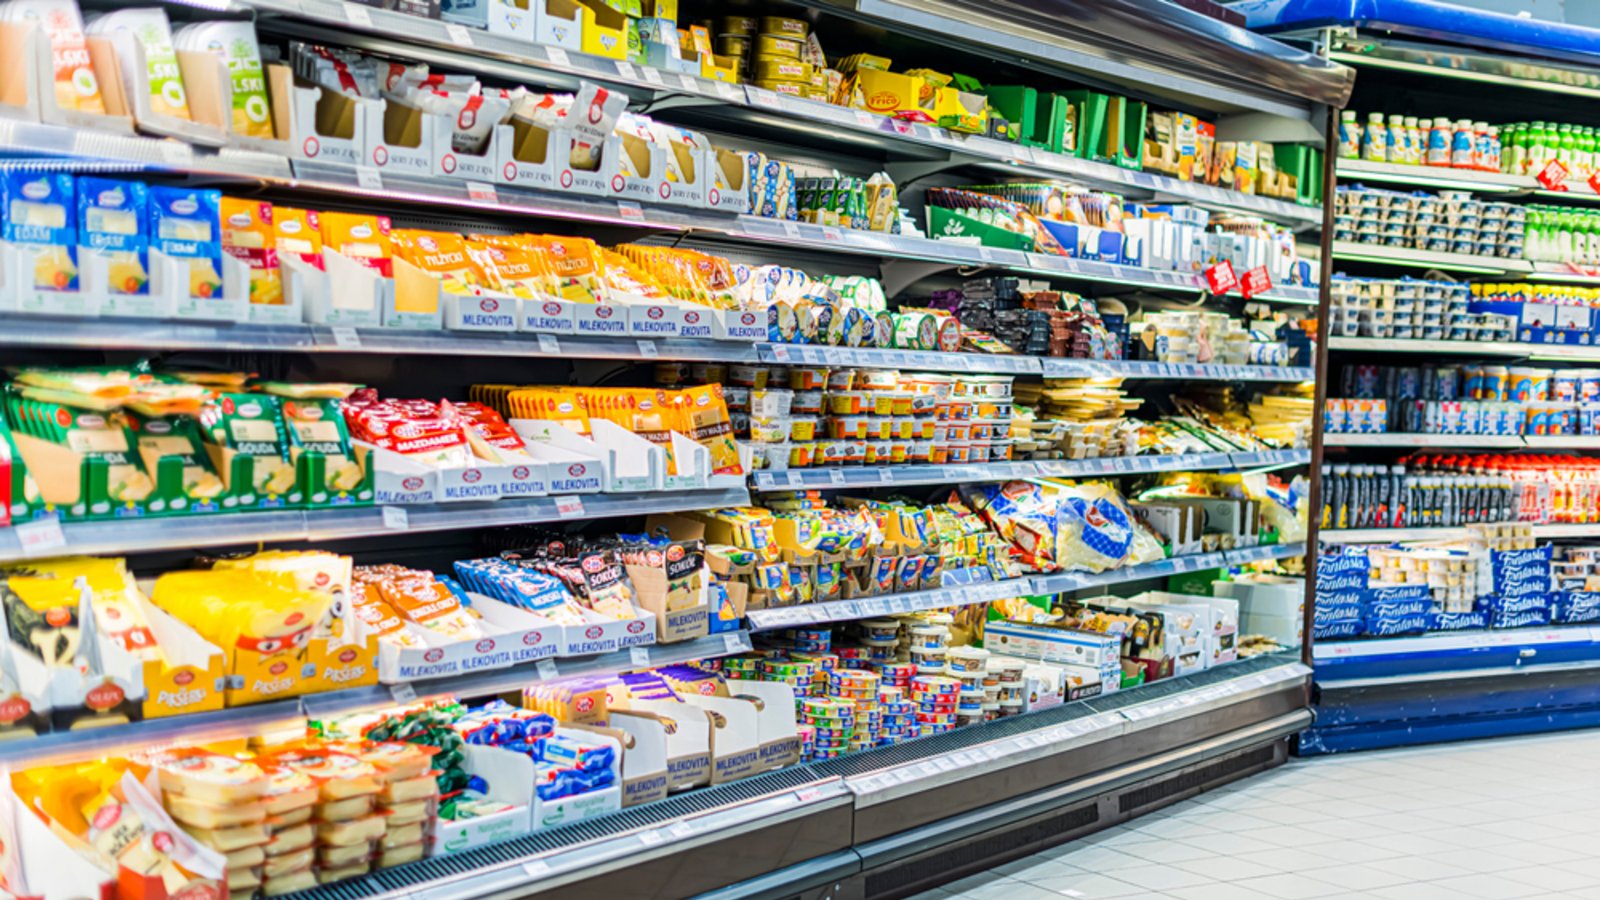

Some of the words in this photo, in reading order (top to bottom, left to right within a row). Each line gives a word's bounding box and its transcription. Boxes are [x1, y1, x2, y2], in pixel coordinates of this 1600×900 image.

[463, 314, 513, 326] MLEKOVITA
[526, 317, 572, 330] MLEKOVITA
[579, 320, 624, 331] MLEKOVITA
[633, 321, 677, 332] MLEKOVITA
[728, 327, 767, 338] MLEKOVITA
[237, 442, 277, 454] GOUDA
[396, 433, 460, 451] MAZDAMER
[445, 484, 498, 498] MLEKOVITA
[551, 478, 599, 490] MLEKOVITA
[376, 490, 433, 503] MLEKOVITA
[1499, 549, 1547, 567] Fantasia
[1500, 565, 1547, 581] Fantasia
[1500, 580, 1546, 597] Fantasia
[1374, 601, 1424, 618] Fantasia
[1498, 596, 1547, 611] Fantasia
[668, 611, 707, 628] MLEKOVITA
[1376, 617, 1426, 636] Fantasia
[1435, 612, 1486, 629] Fantasia
[1496, 611, 1545, 628] Fantasia
[568, 640, 616, 654] MLEKOVITA
[400, 661, 458, 677] MLEKOVITA
[760, 740, 800, 758] MLEKOVITA
[667, 756, 709, 773] MLEKOVITA
[716, 752, 758, 770] MLEKOVITA
[625, 776, 667, 794] MLEKOVITA
